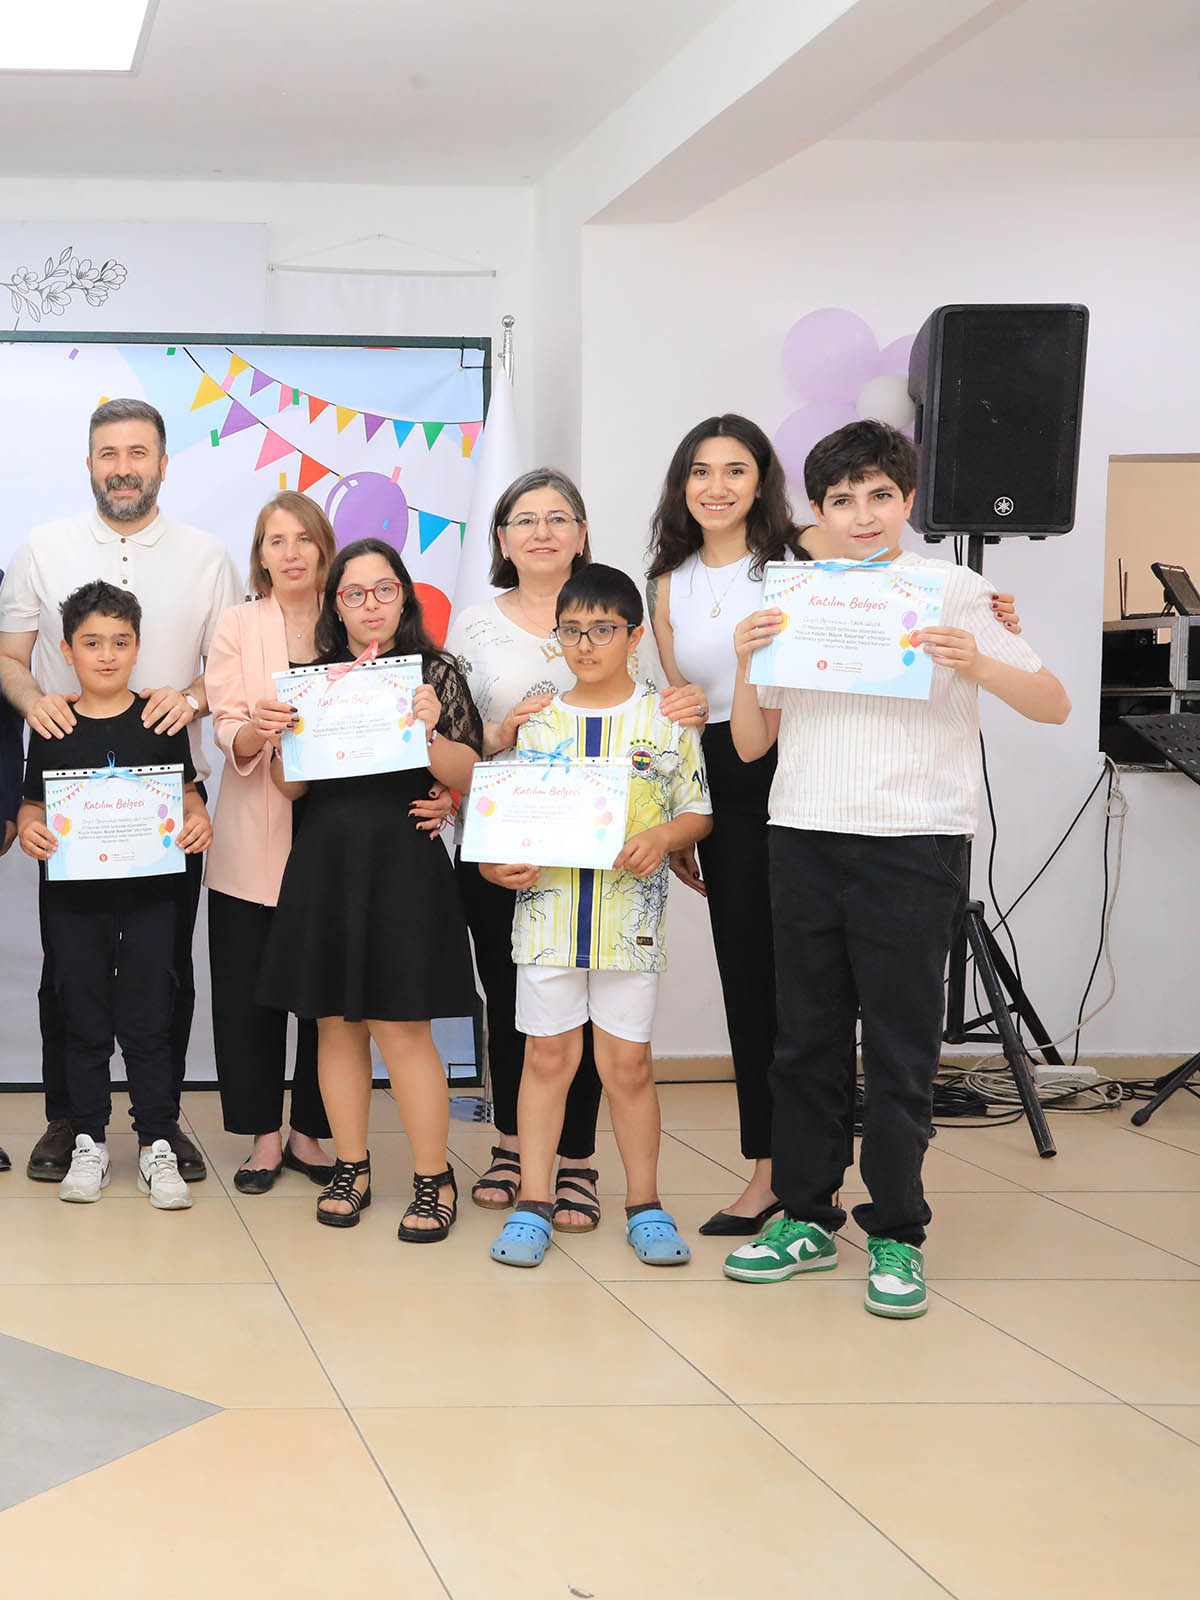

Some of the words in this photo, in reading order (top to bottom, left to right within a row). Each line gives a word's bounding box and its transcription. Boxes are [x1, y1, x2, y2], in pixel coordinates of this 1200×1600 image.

[808, 595, 846, 608] Katılım
[849, 596, 888, 612] Belgesi
[513, 786, 546, 796] Katılım
[83, 800, 114, 811] Katılım
[115, 799, 145, 812] Belgesi
